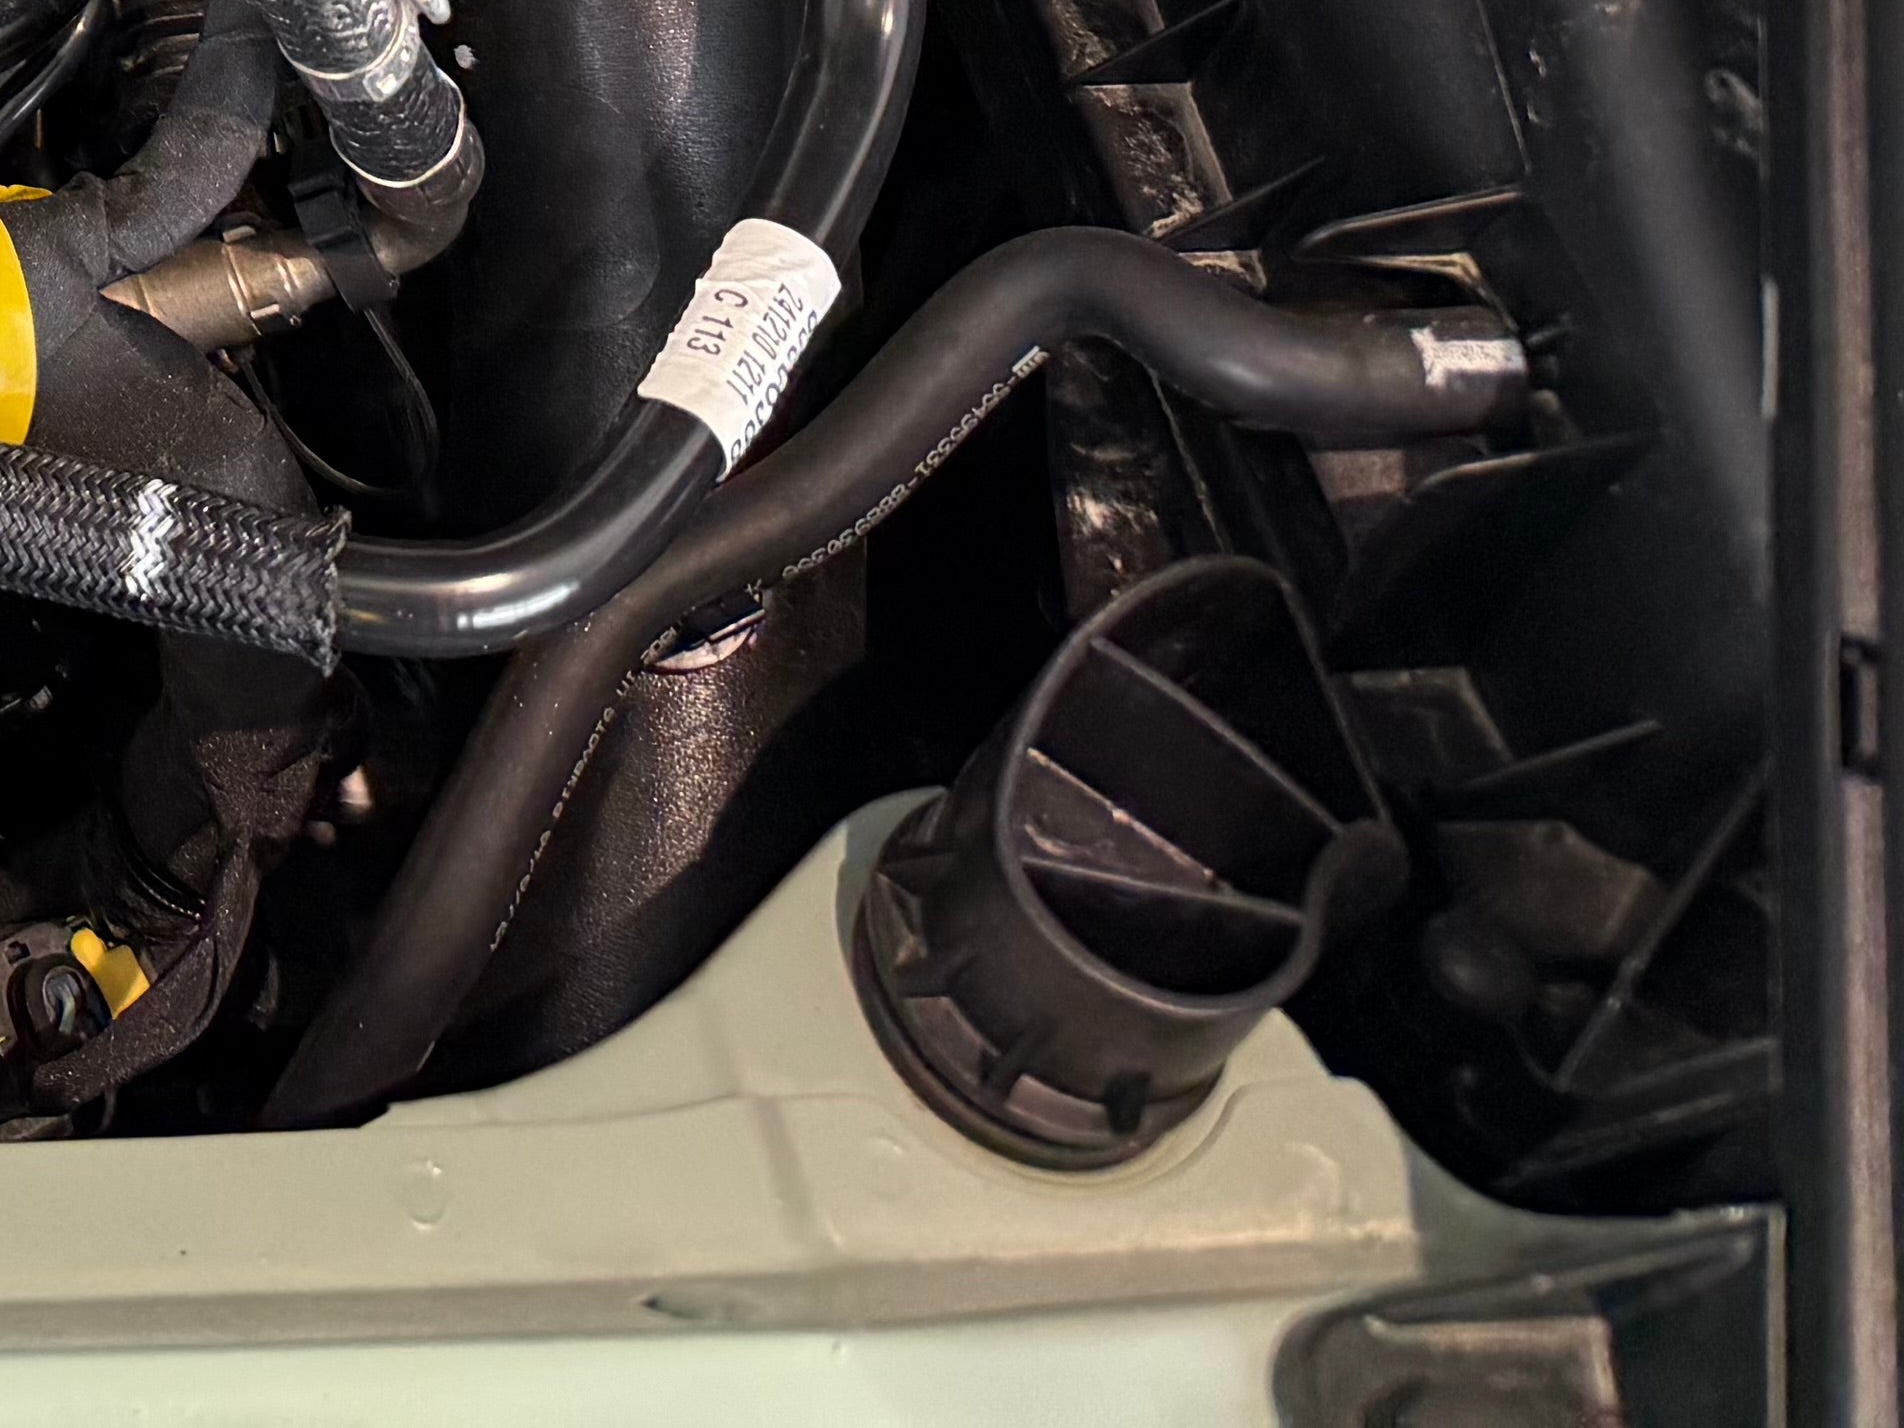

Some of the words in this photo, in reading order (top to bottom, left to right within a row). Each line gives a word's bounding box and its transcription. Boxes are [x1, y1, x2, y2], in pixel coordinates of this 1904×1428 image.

[713, 287, 748, 308] C
[686, 316, 734, 357] 113
[726, 356, 768, 408] 1211
